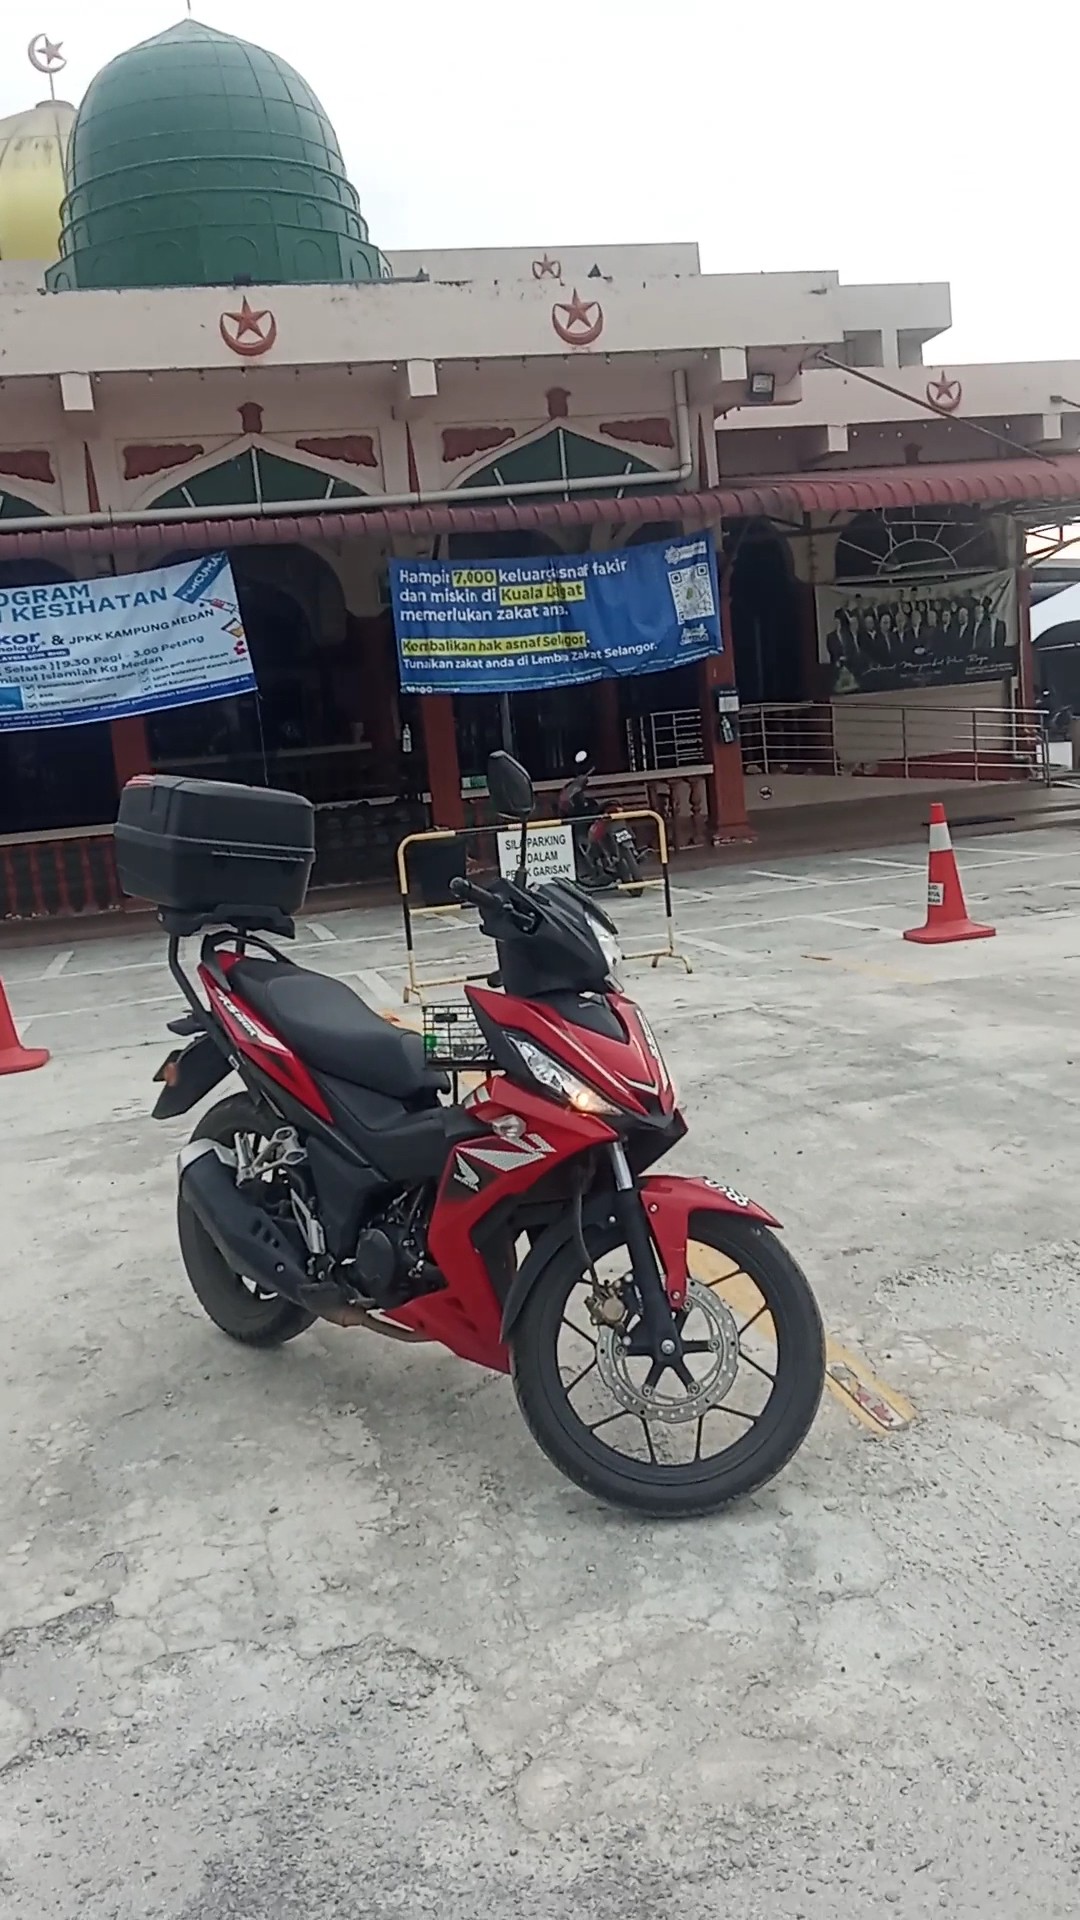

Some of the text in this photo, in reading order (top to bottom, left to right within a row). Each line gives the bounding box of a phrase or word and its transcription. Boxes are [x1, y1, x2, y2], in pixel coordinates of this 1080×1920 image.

[399, 568, 450, 587] Hampir
[592, 558, 627, 576] fakir
[399, 588, 426, 602] dan
[431, 588, 478, 603] miskin
[482, 588, 497, 602] di
[502, 586, 543, 601] Kuala
[11, 586, 167, 622] KESIHATAN
[399, 608, 492, 621] memerlukan
[496, 606, 540, 620] zakat
[69, 633, 103, 645] JPKK
[105, 619, 169, 640] KAMPUNG
[171, 608, 215, 627] MEDAN
[479, 639, 502, 652] hak
[505, 635, 540, 650] asnaf
[455, 658, 483, 669] zakat
[485, 657, 514, 668] anda
[517, 655, 529, 666] di
[505, 834, 566, 850] SIL PARKING
[527, 850, 558, 864] DALAM
